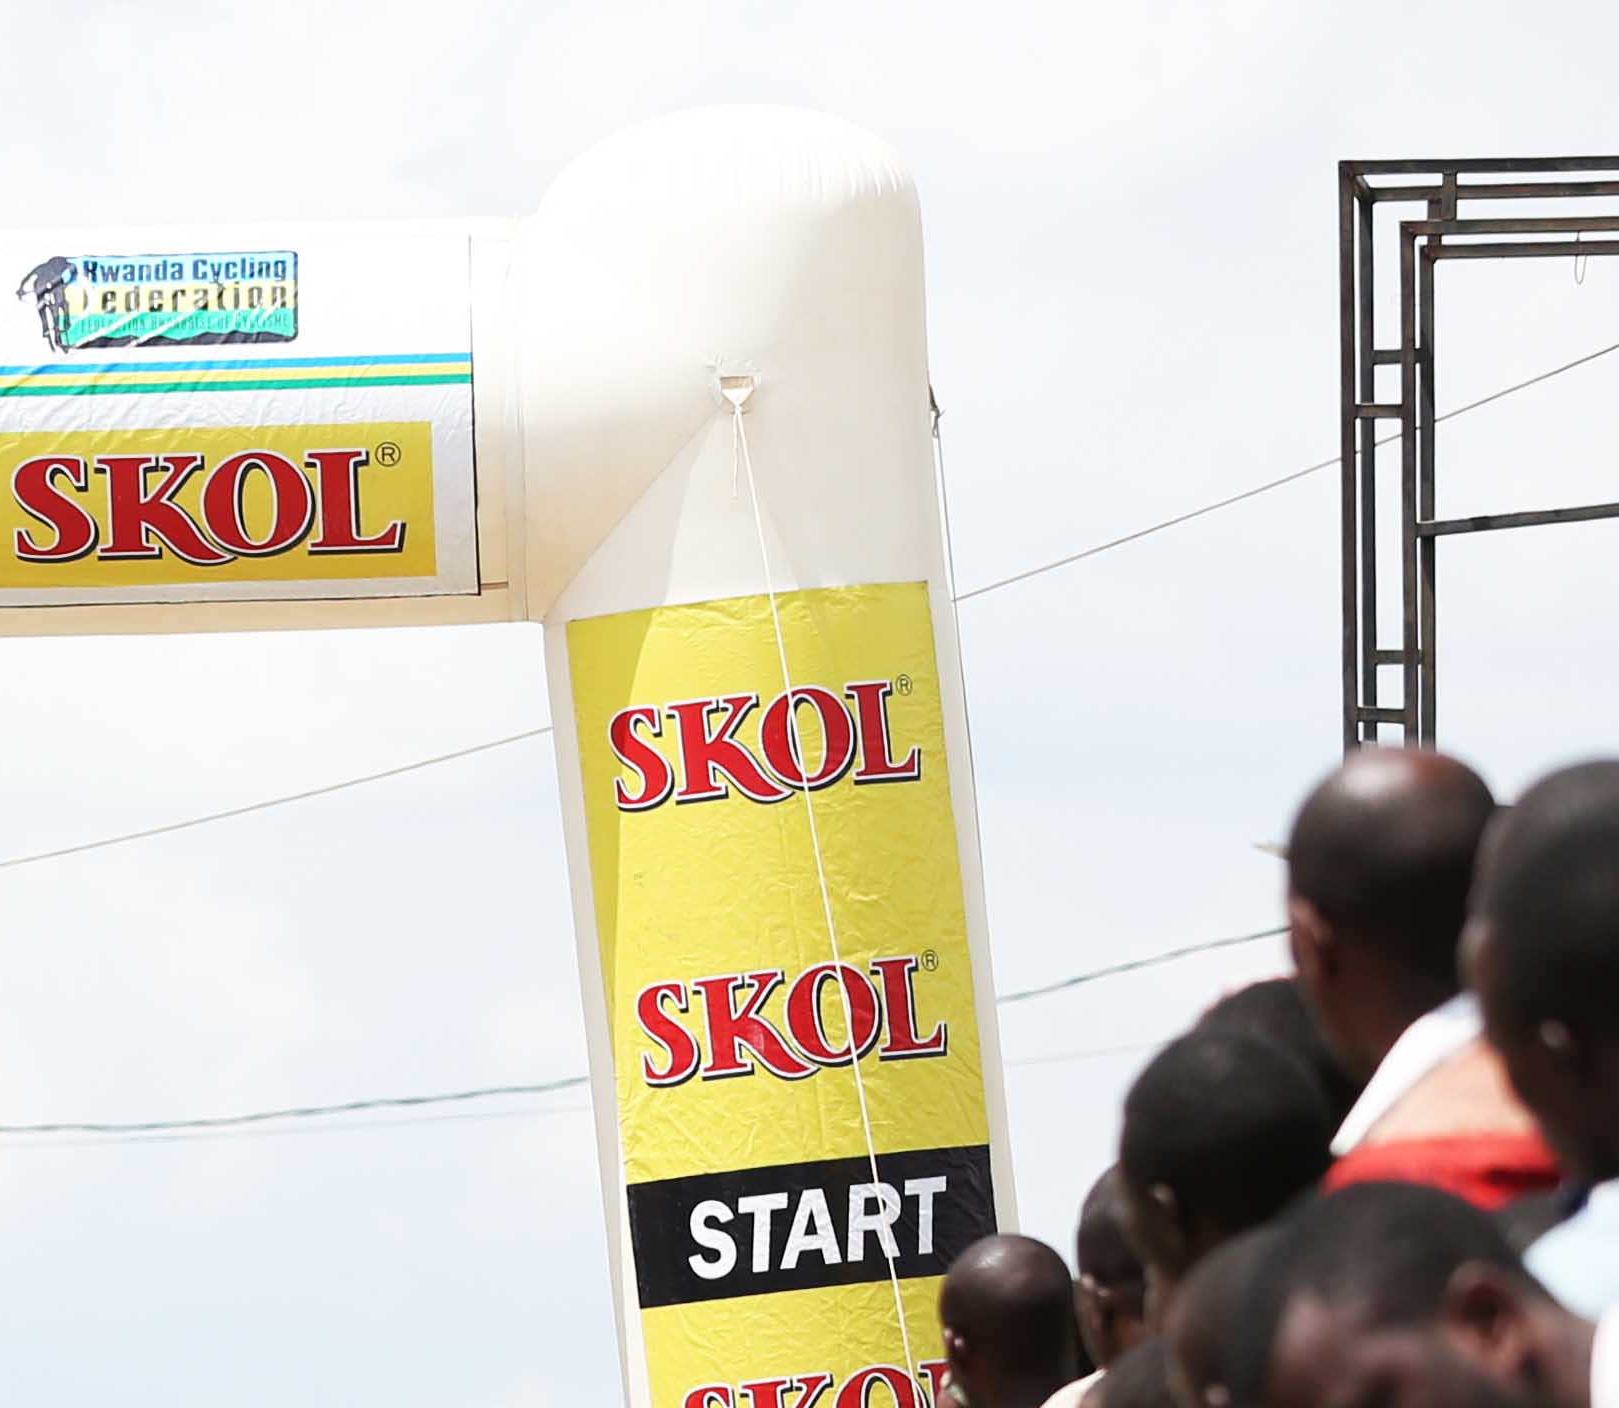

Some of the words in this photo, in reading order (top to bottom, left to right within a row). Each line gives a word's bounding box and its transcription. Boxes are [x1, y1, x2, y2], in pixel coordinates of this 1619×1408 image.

[83, 258, 184, 283] Rwanda
[193, 257, 287, 283] Cycling
[687, 1175, 948, 1280] START
